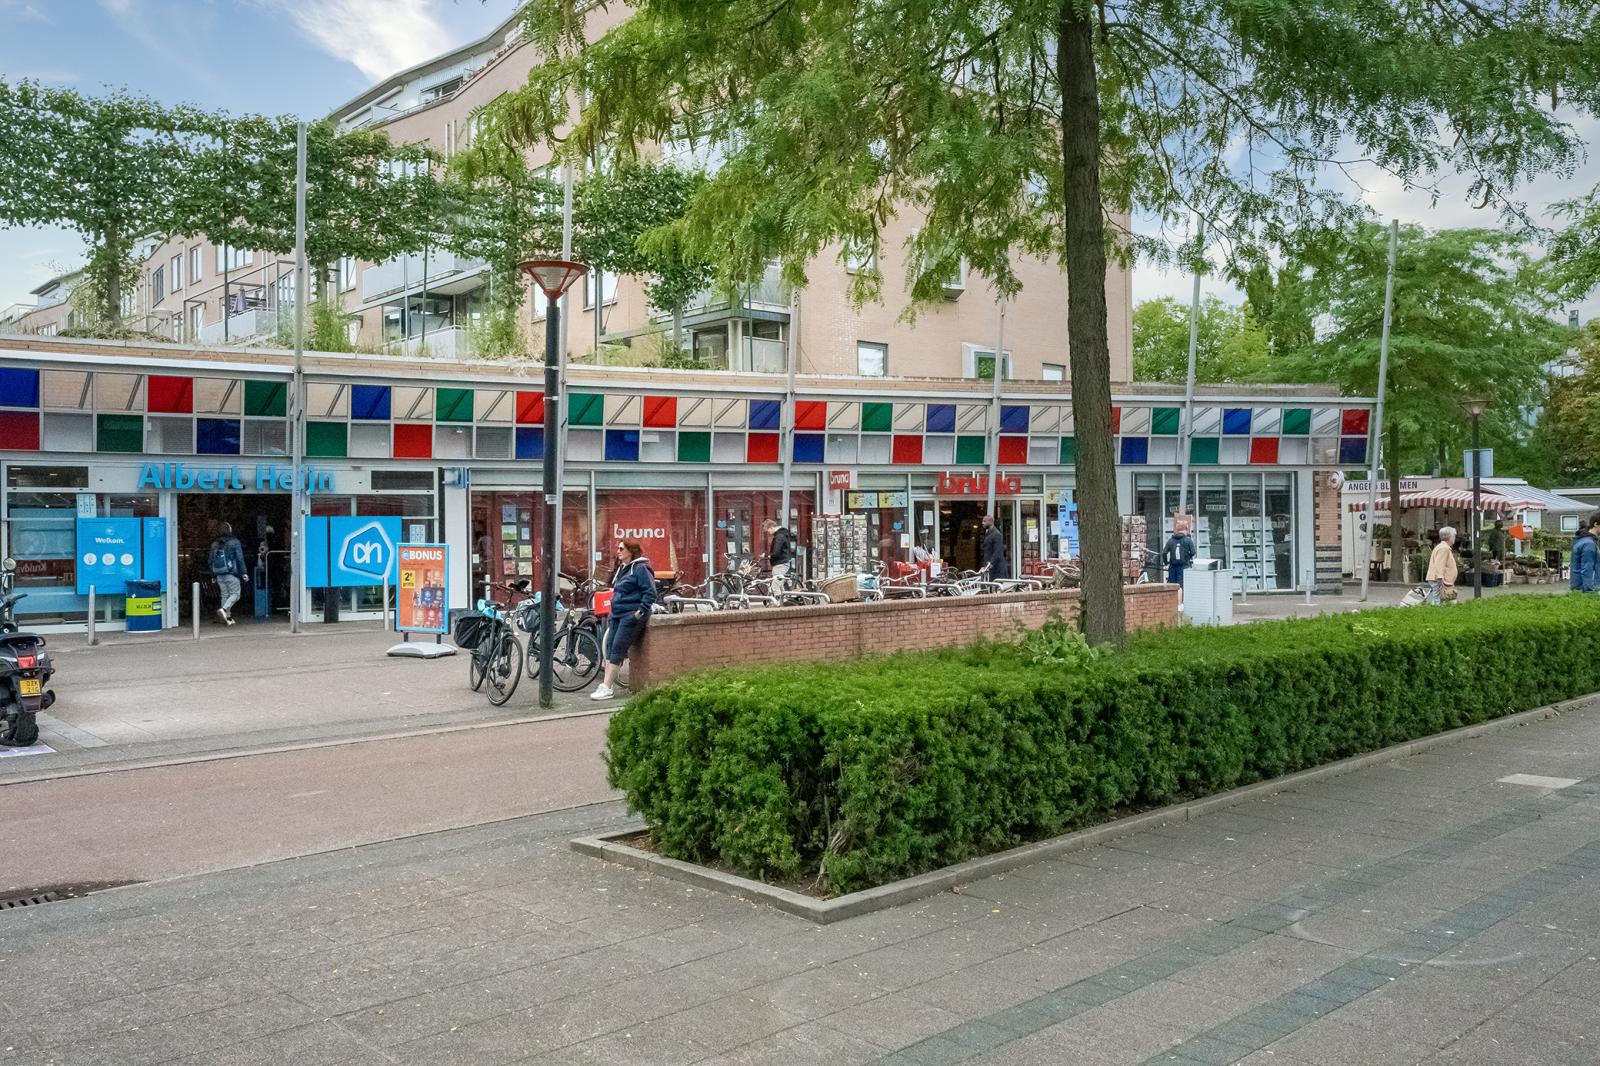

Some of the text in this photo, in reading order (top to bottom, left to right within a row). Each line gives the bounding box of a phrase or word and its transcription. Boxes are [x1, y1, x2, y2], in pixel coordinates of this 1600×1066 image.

[139, 462, 335, 496] Albert Heijn
[939, 471, 1021, 496] bruna
[1380, 481, 1418, 490] BLMEN
[613, 523, 664, 539] bruna
[409, 550, 443, 560] BONUS
